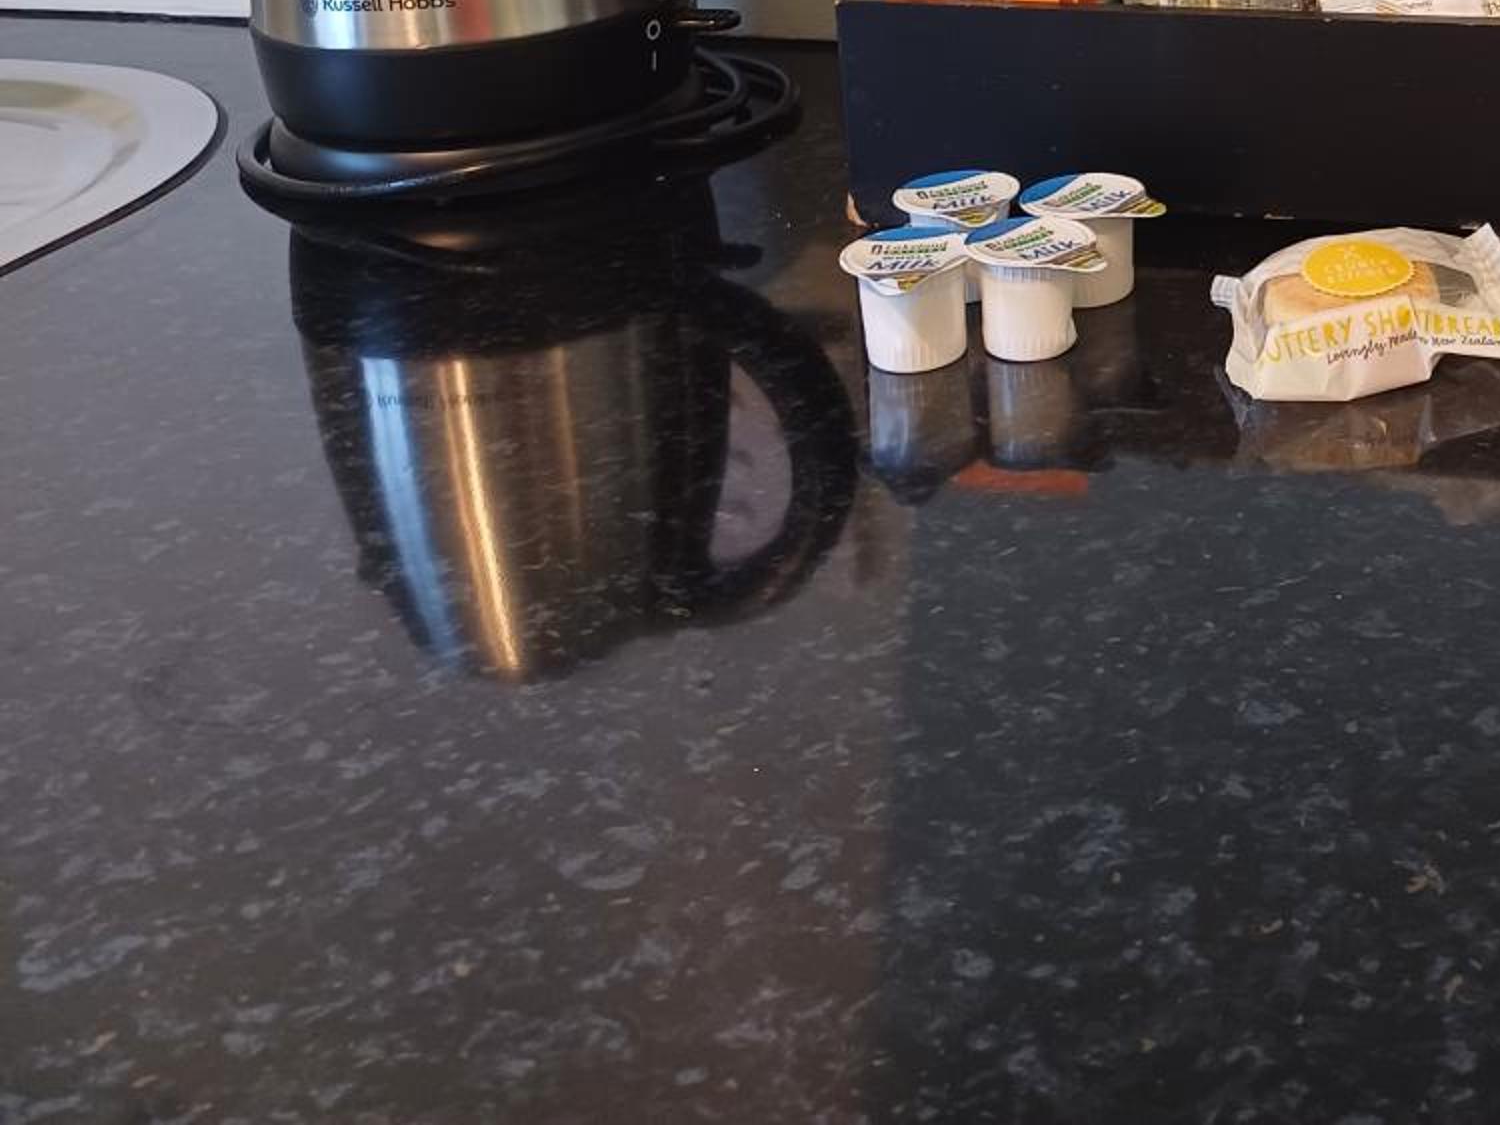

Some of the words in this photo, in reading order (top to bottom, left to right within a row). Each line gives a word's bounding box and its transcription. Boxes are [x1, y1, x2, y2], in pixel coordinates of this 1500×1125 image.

[1019, 239, 1074, 260] Milk
[867, 259, 938, 271] Milk
[1264, 317, 1353, 363] UTTERY
